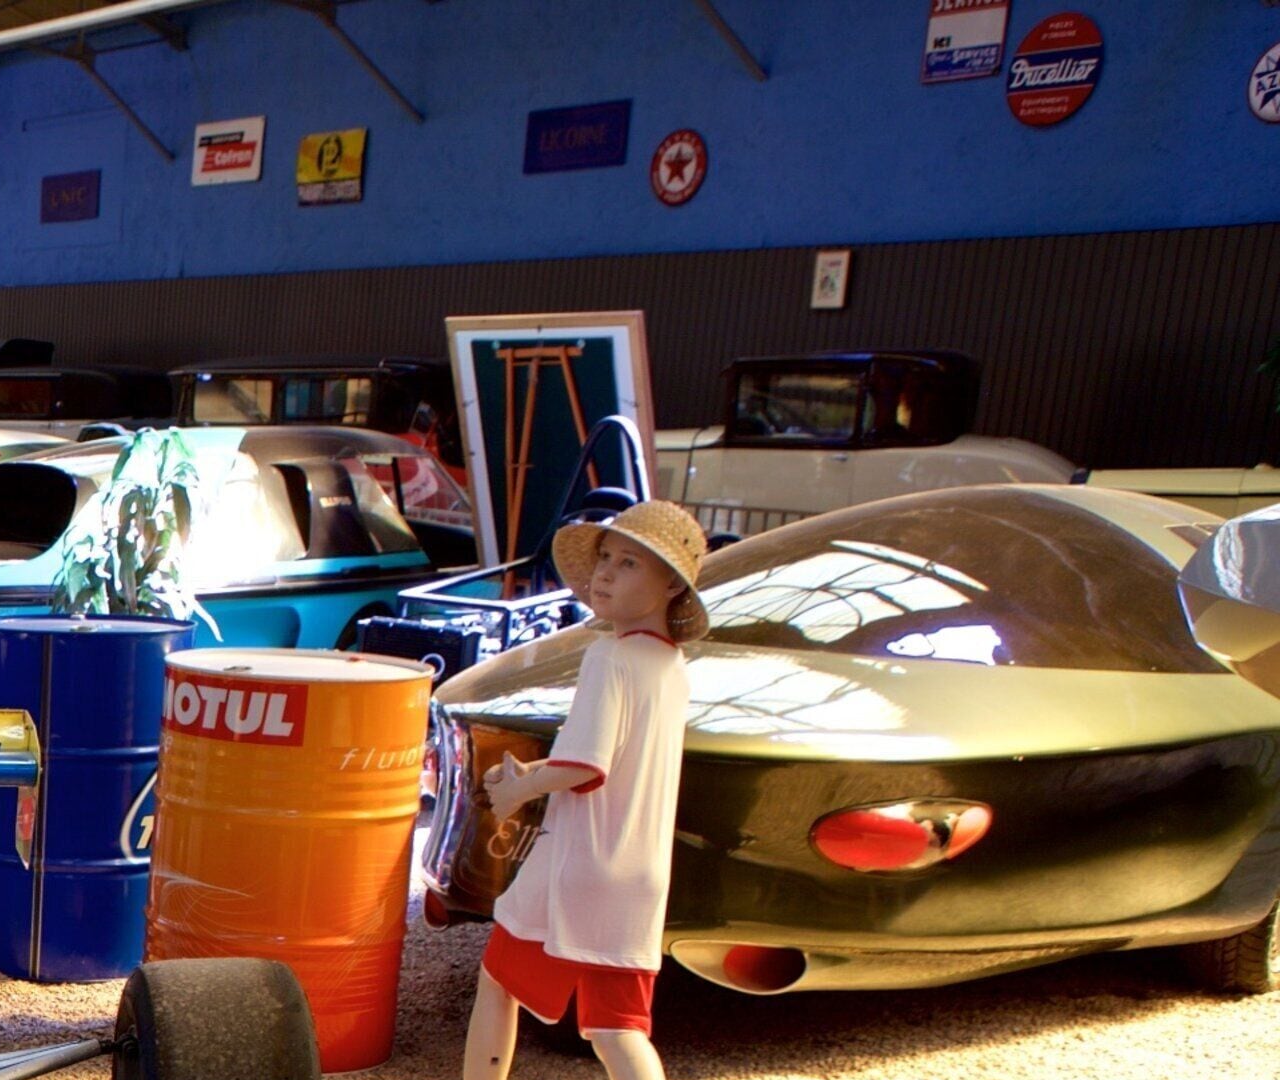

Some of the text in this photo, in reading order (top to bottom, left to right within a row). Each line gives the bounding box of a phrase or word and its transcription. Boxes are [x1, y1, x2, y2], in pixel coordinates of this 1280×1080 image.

[1009, 58, 1100, 89] Ducellier
[1255, 73, 1280, 97] AZ
[164, 679, 295, 738] MOTUL
